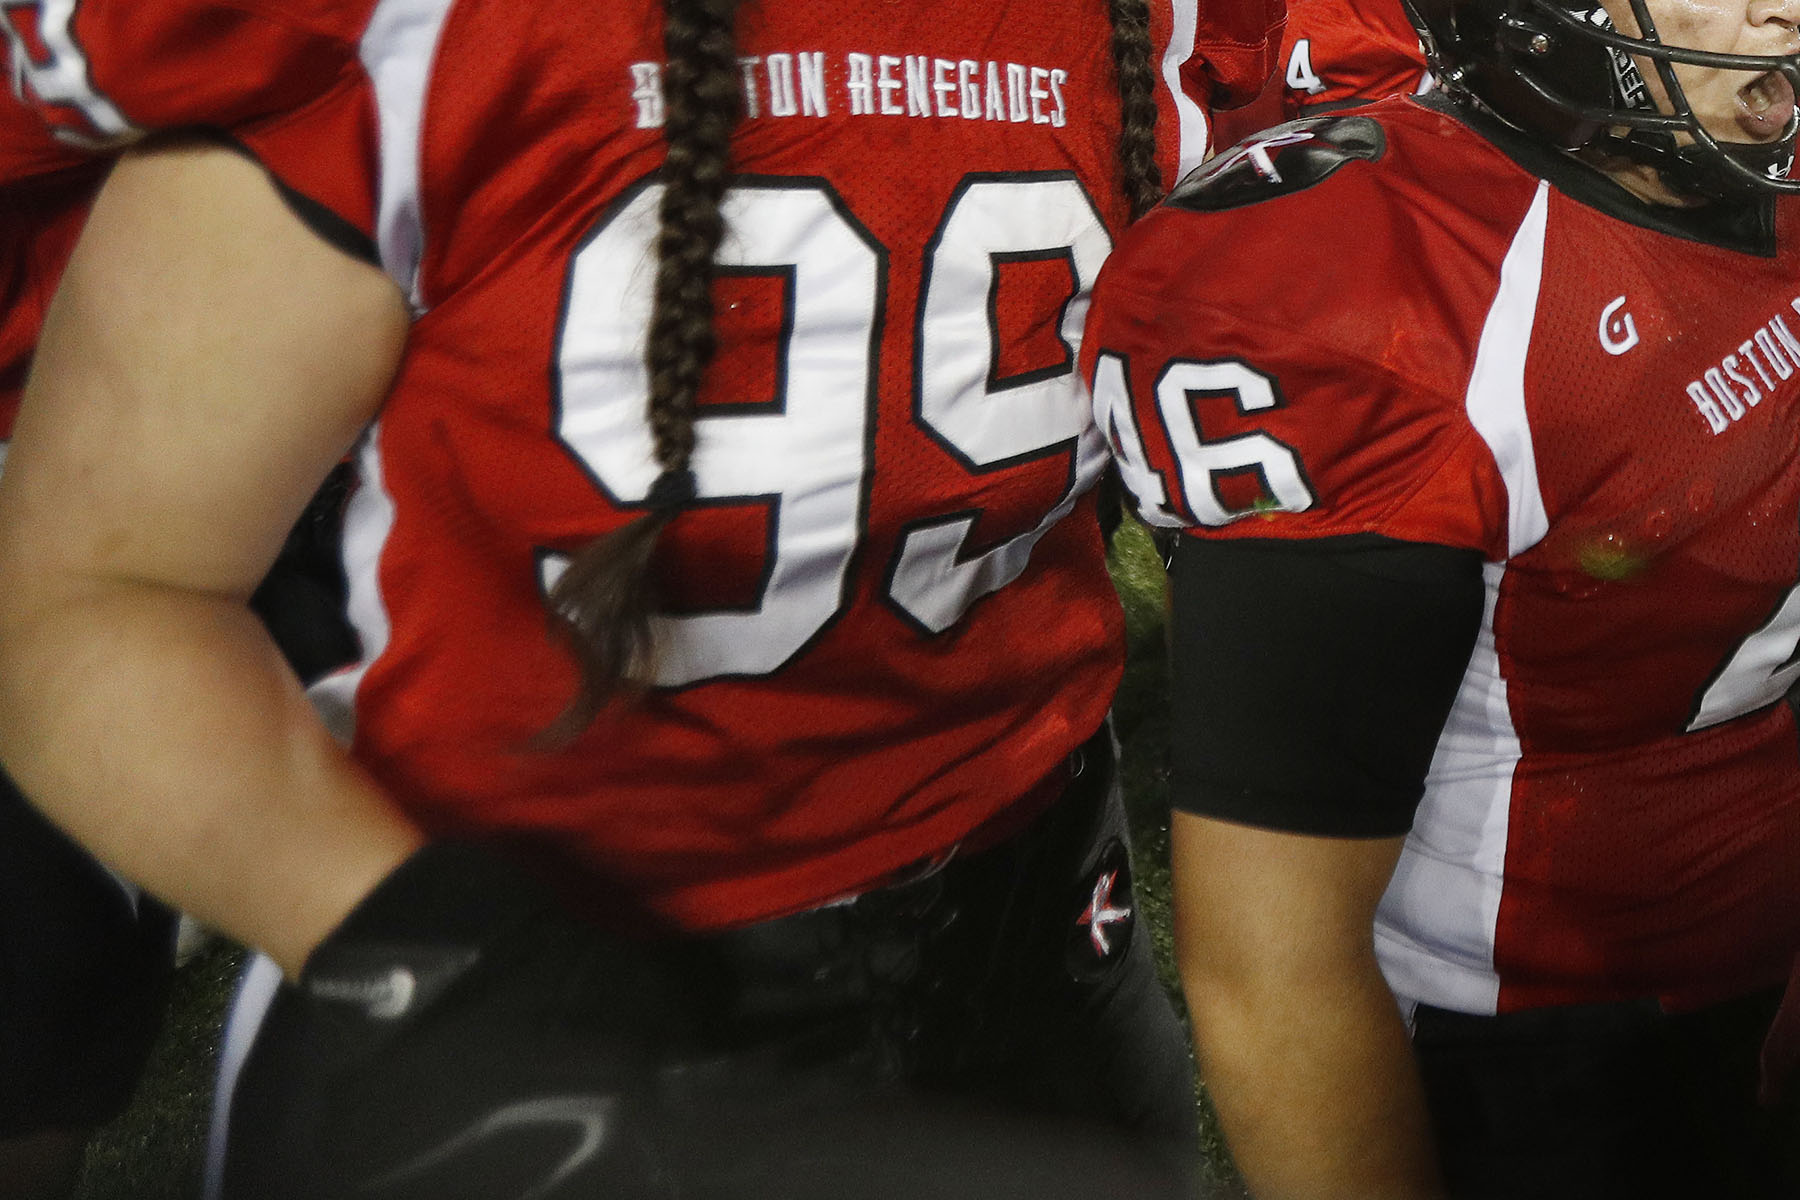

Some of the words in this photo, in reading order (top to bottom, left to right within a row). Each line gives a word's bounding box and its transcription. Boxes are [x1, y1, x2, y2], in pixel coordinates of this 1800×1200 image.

[630, 51, 828, 130] BTON
[848, 51, 1069, 129] RENEGADES
[536, 172, 1115, 688] 99
[1091, 348, 1320, 529] 46
